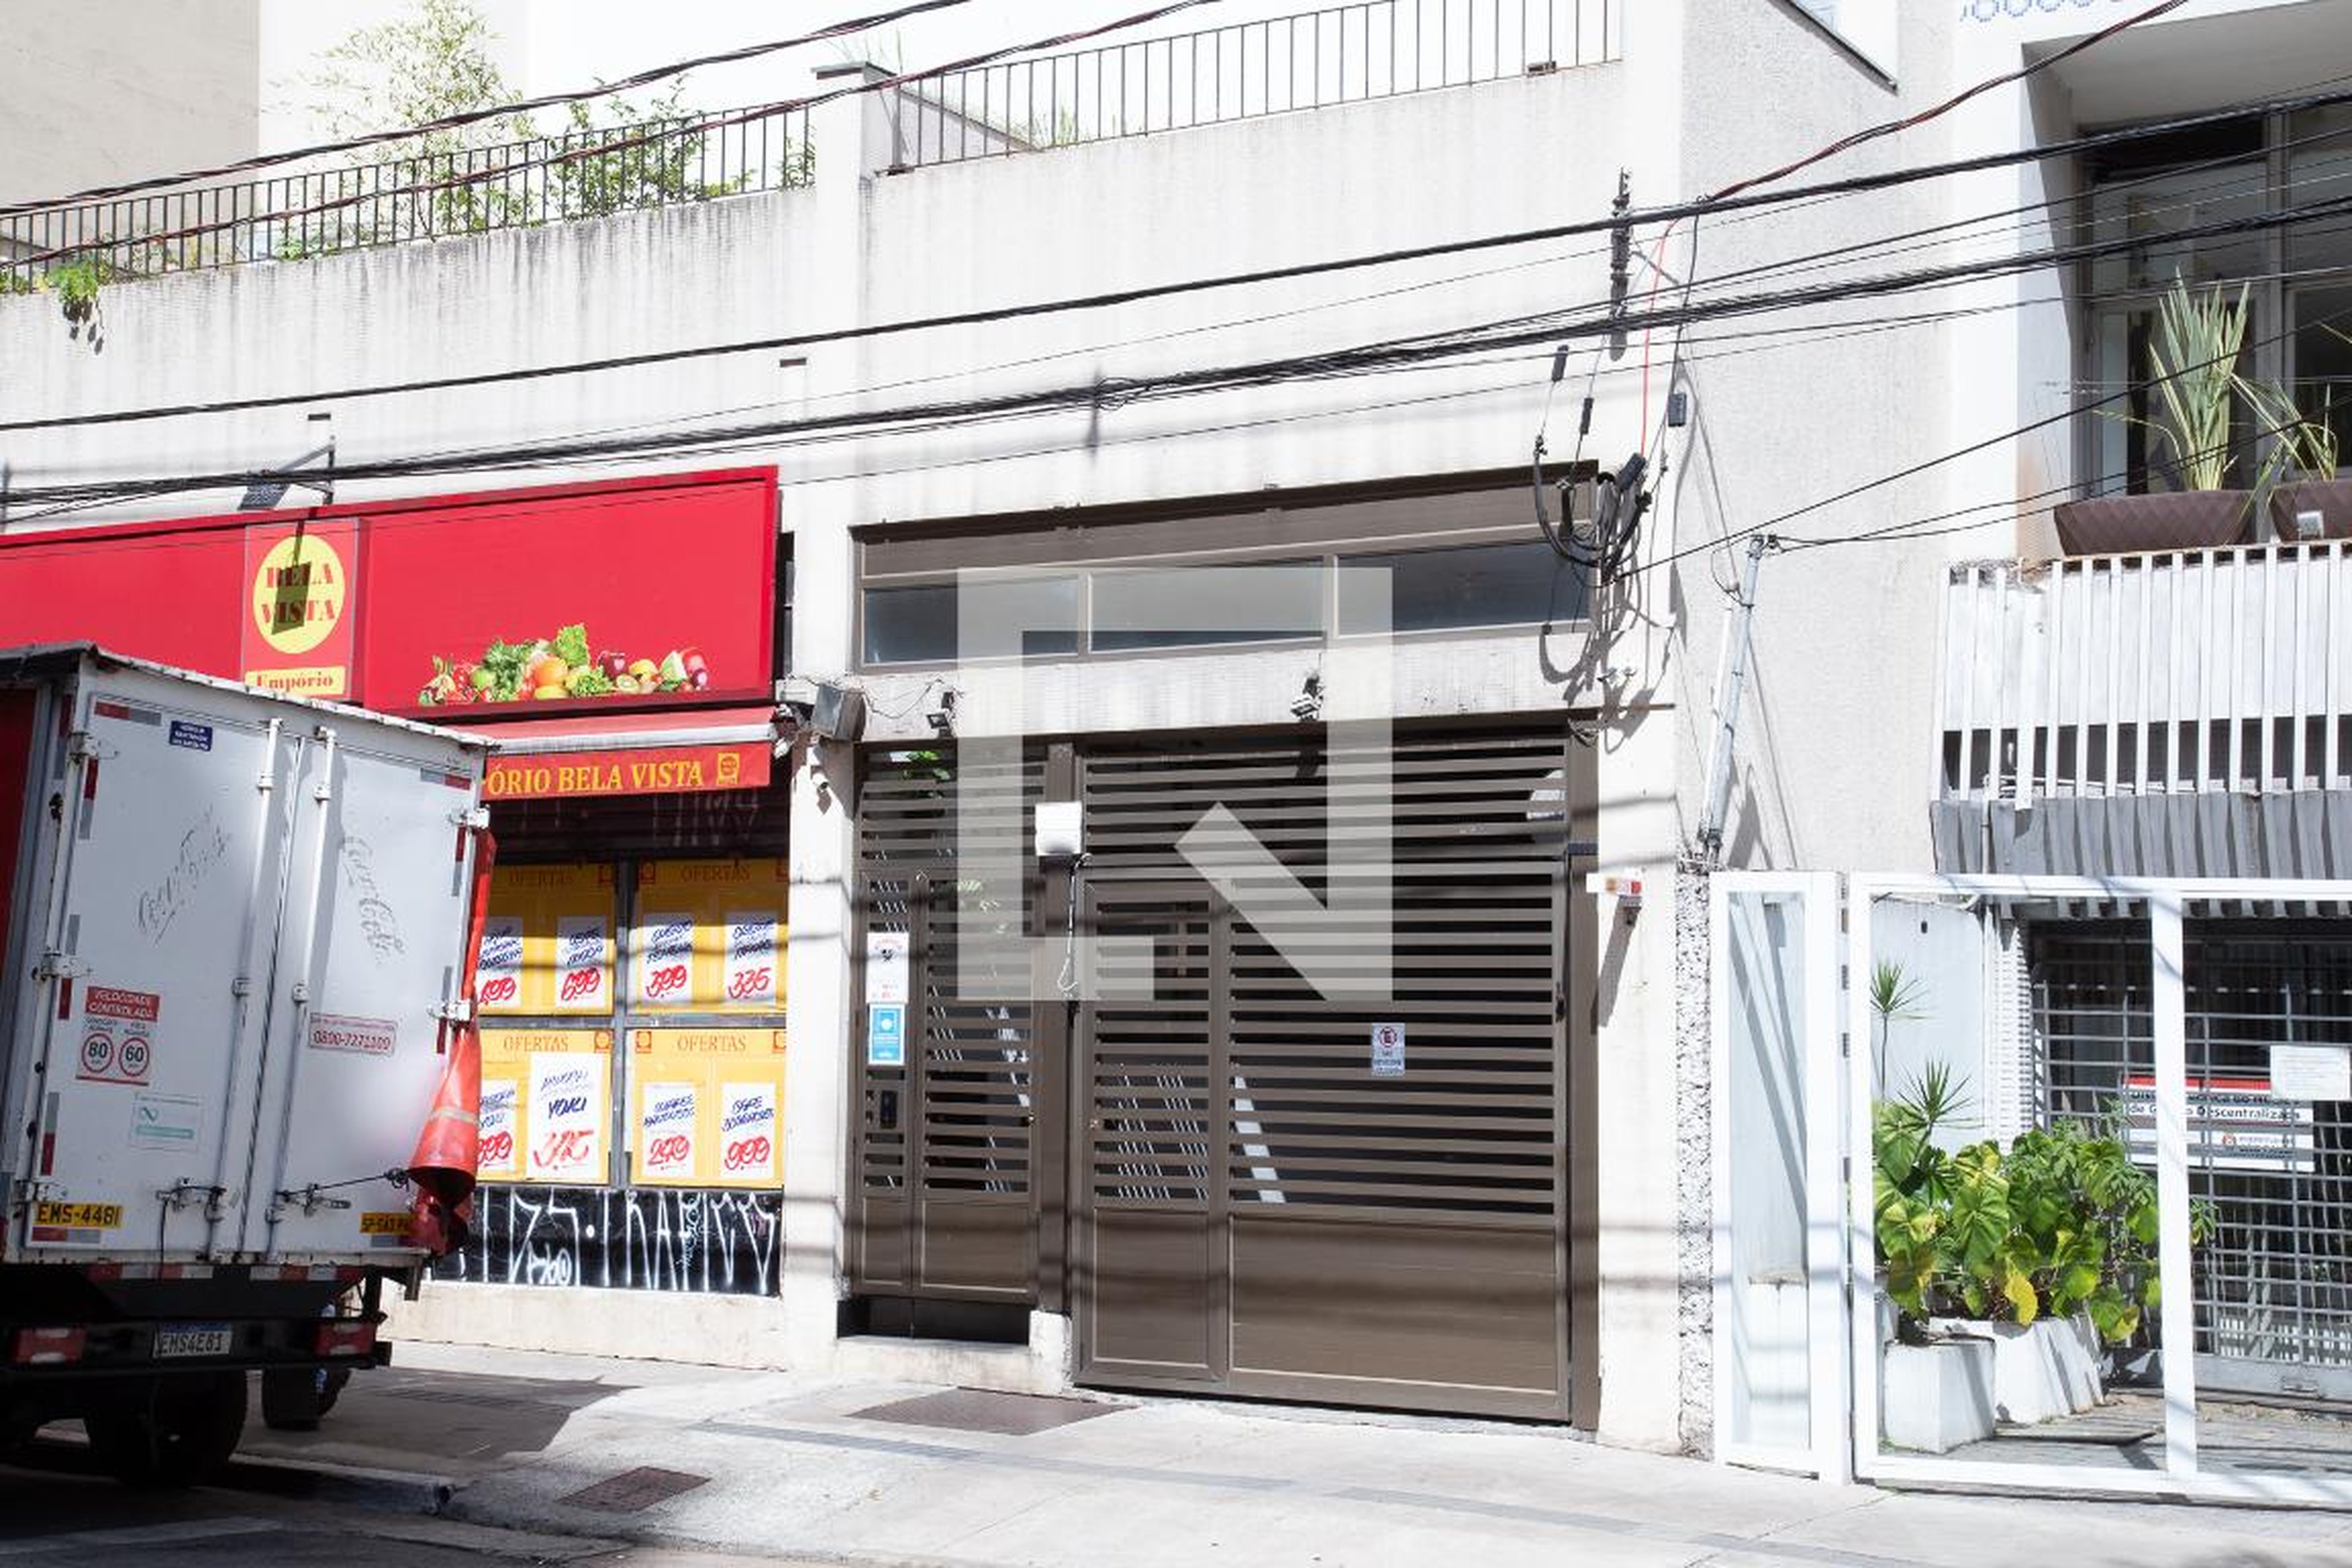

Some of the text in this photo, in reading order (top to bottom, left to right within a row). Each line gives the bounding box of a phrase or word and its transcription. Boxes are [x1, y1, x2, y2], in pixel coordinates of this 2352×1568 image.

[266, 564, 333, 588] BELA
[262, 599, 335, 624] VISTA
[483, 763, 550, 795] ÓRIO
[558, 767, 622, 792] BELA
[631, 761, 704, 788] VISTA
[681, 864, 751, 882] OFERTAS
[89, 1042, 108, 1058] 80
[503, 1035, 570, 1052] OFERTAS
[677, 1035, 747, 1052] OFERTAS
[126, 1045, 144, 1062] 60
